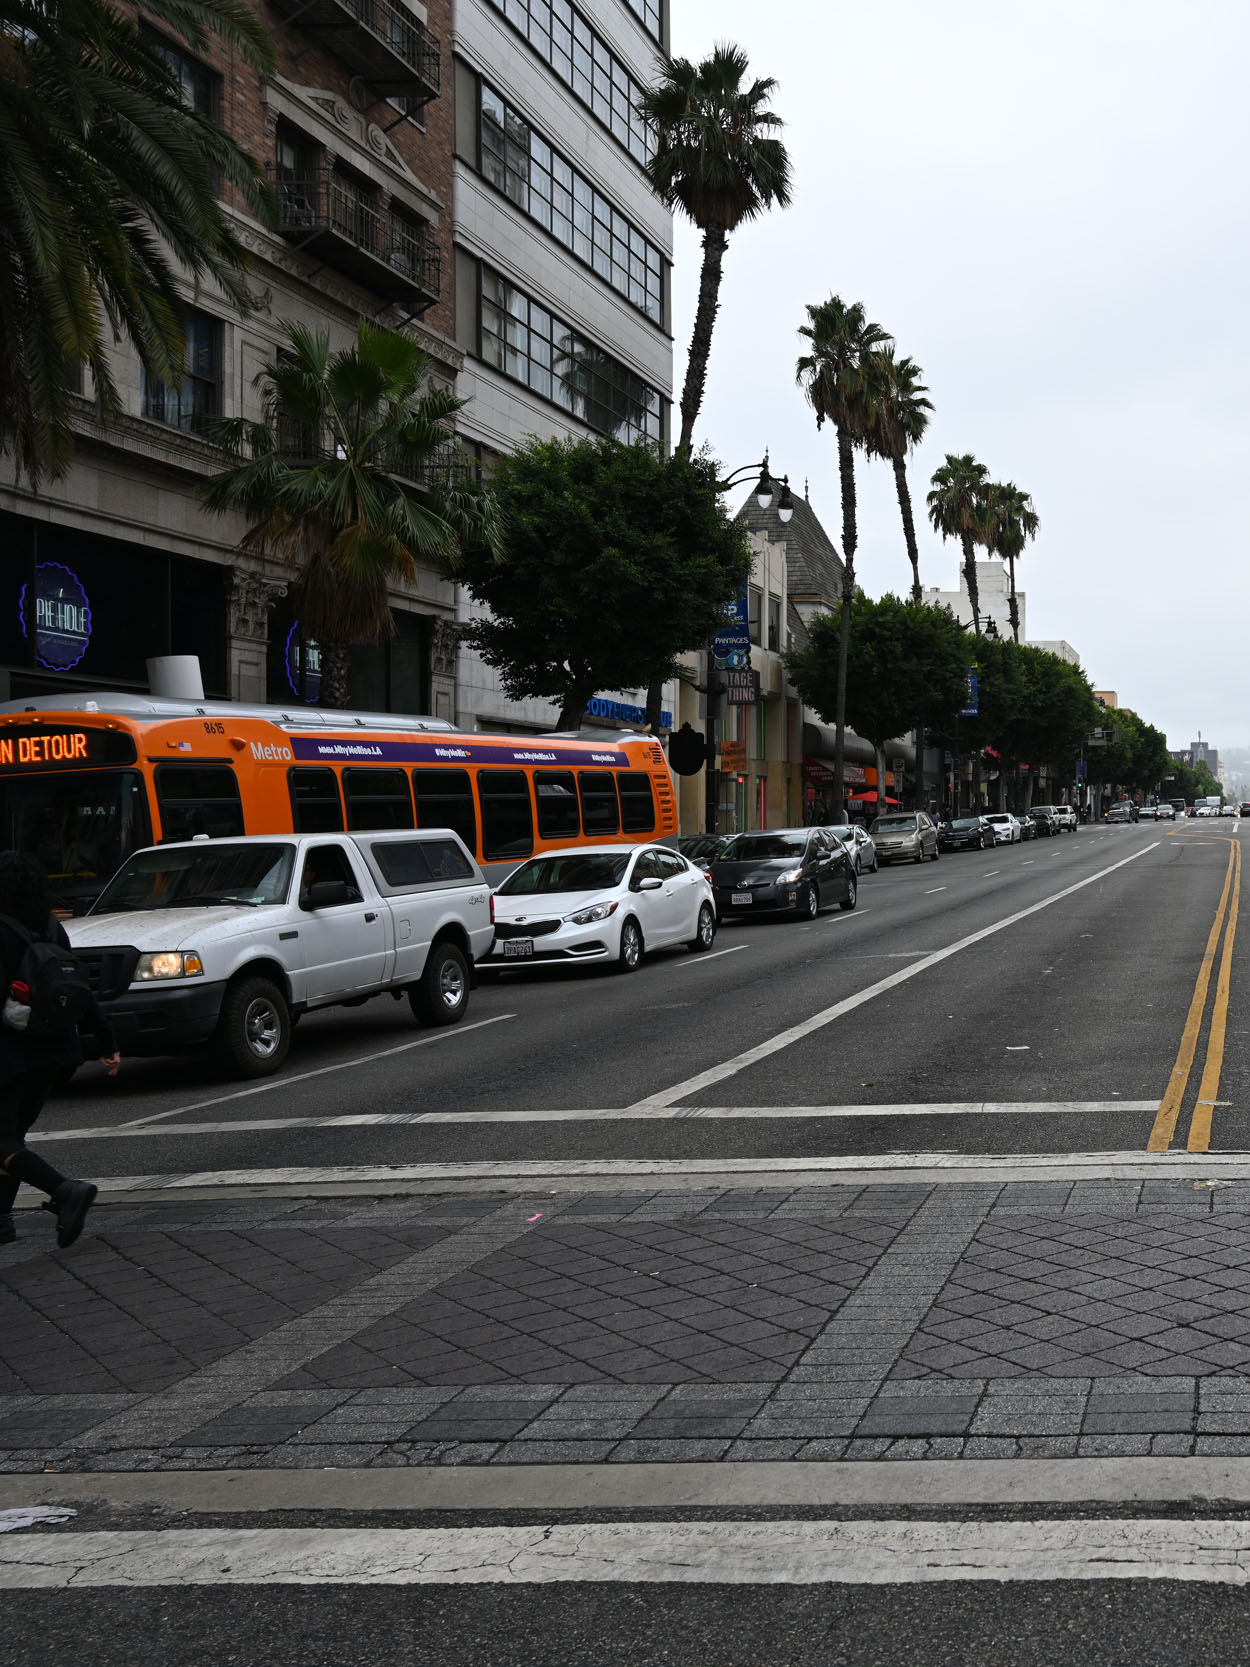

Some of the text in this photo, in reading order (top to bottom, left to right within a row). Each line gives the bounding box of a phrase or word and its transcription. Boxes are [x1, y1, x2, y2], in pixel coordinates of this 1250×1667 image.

[36, 598, 56, 628] PIE
[714, 637, 749, 645] PANTAGES
[727, 672, 753, 687] TAGE
[203, 722, 225, 735] 8615
[0, 732, 88, 764] N DETOUR
[250, 741, 292, 761] Metro
